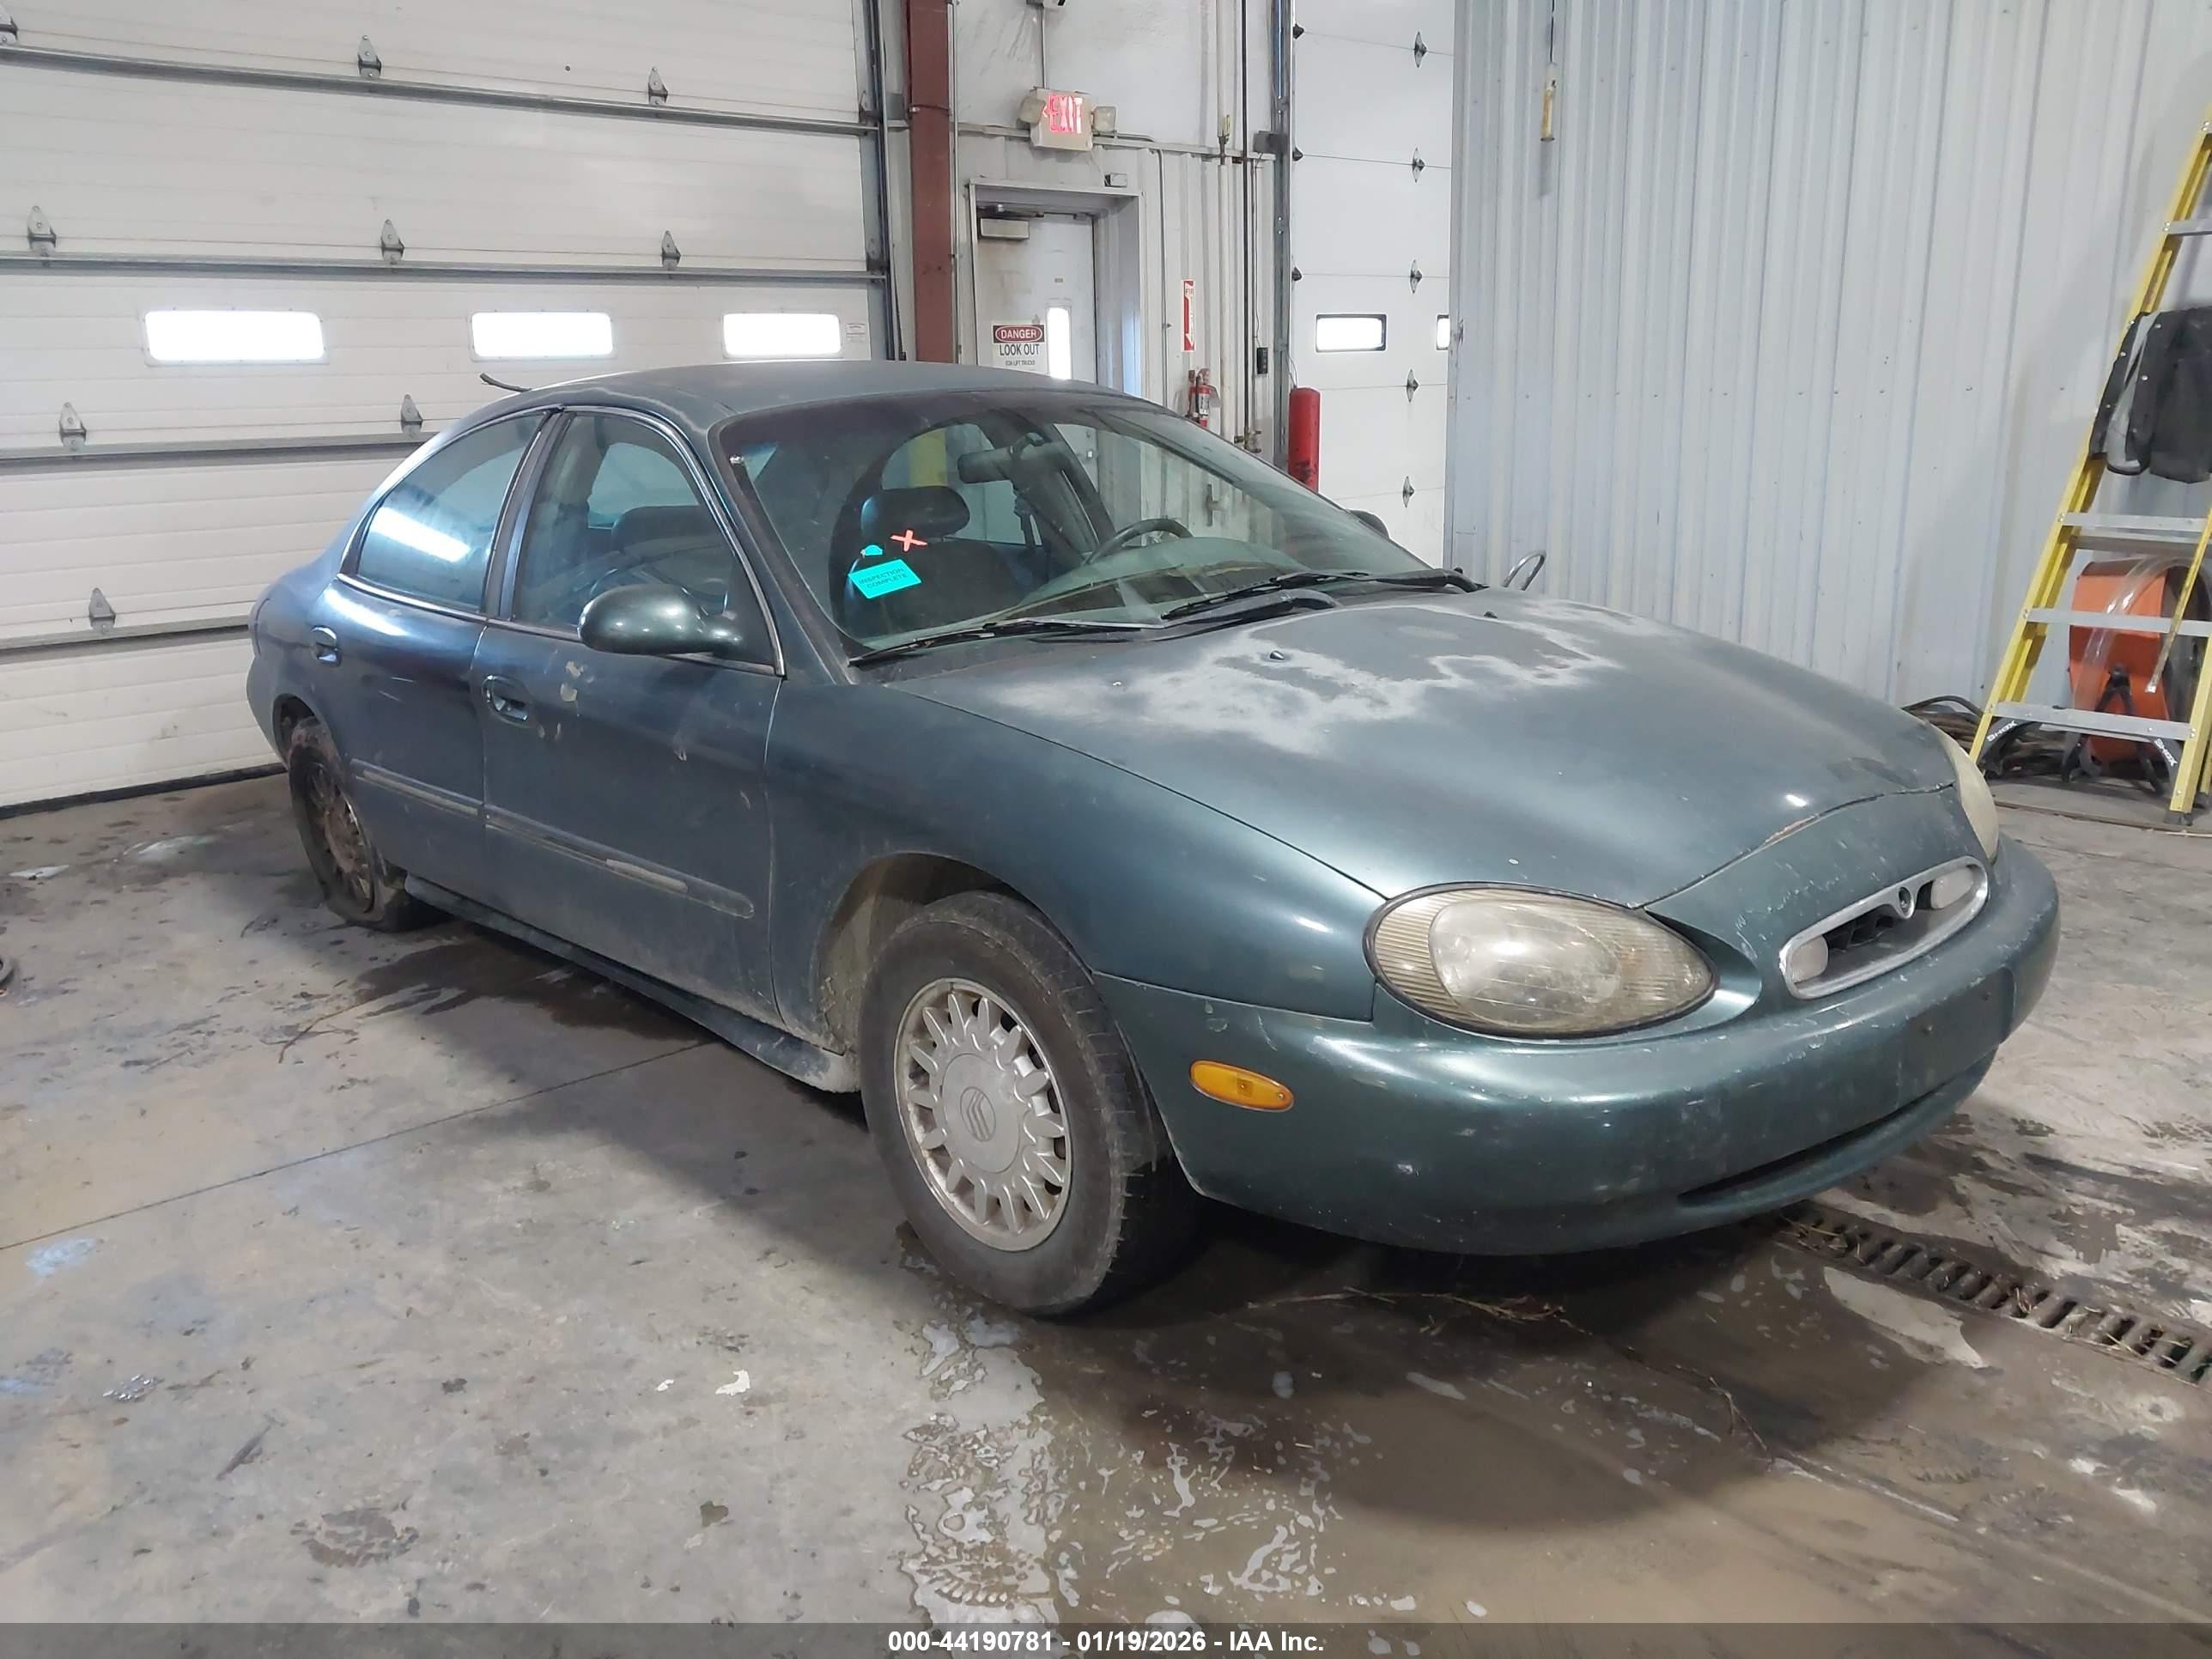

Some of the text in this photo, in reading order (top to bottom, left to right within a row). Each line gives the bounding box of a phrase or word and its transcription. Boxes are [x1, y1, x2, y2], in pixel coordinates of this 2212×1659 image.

[1048, 94, 1083, 133] EXIT
[1000, 329, 1037, 339] DANGER
[1000, 343, 1040, 356] LOOK OUT
[859, 568, 905, 585] INSPECTION
[866, 573, 908, 589] COMPLETE
